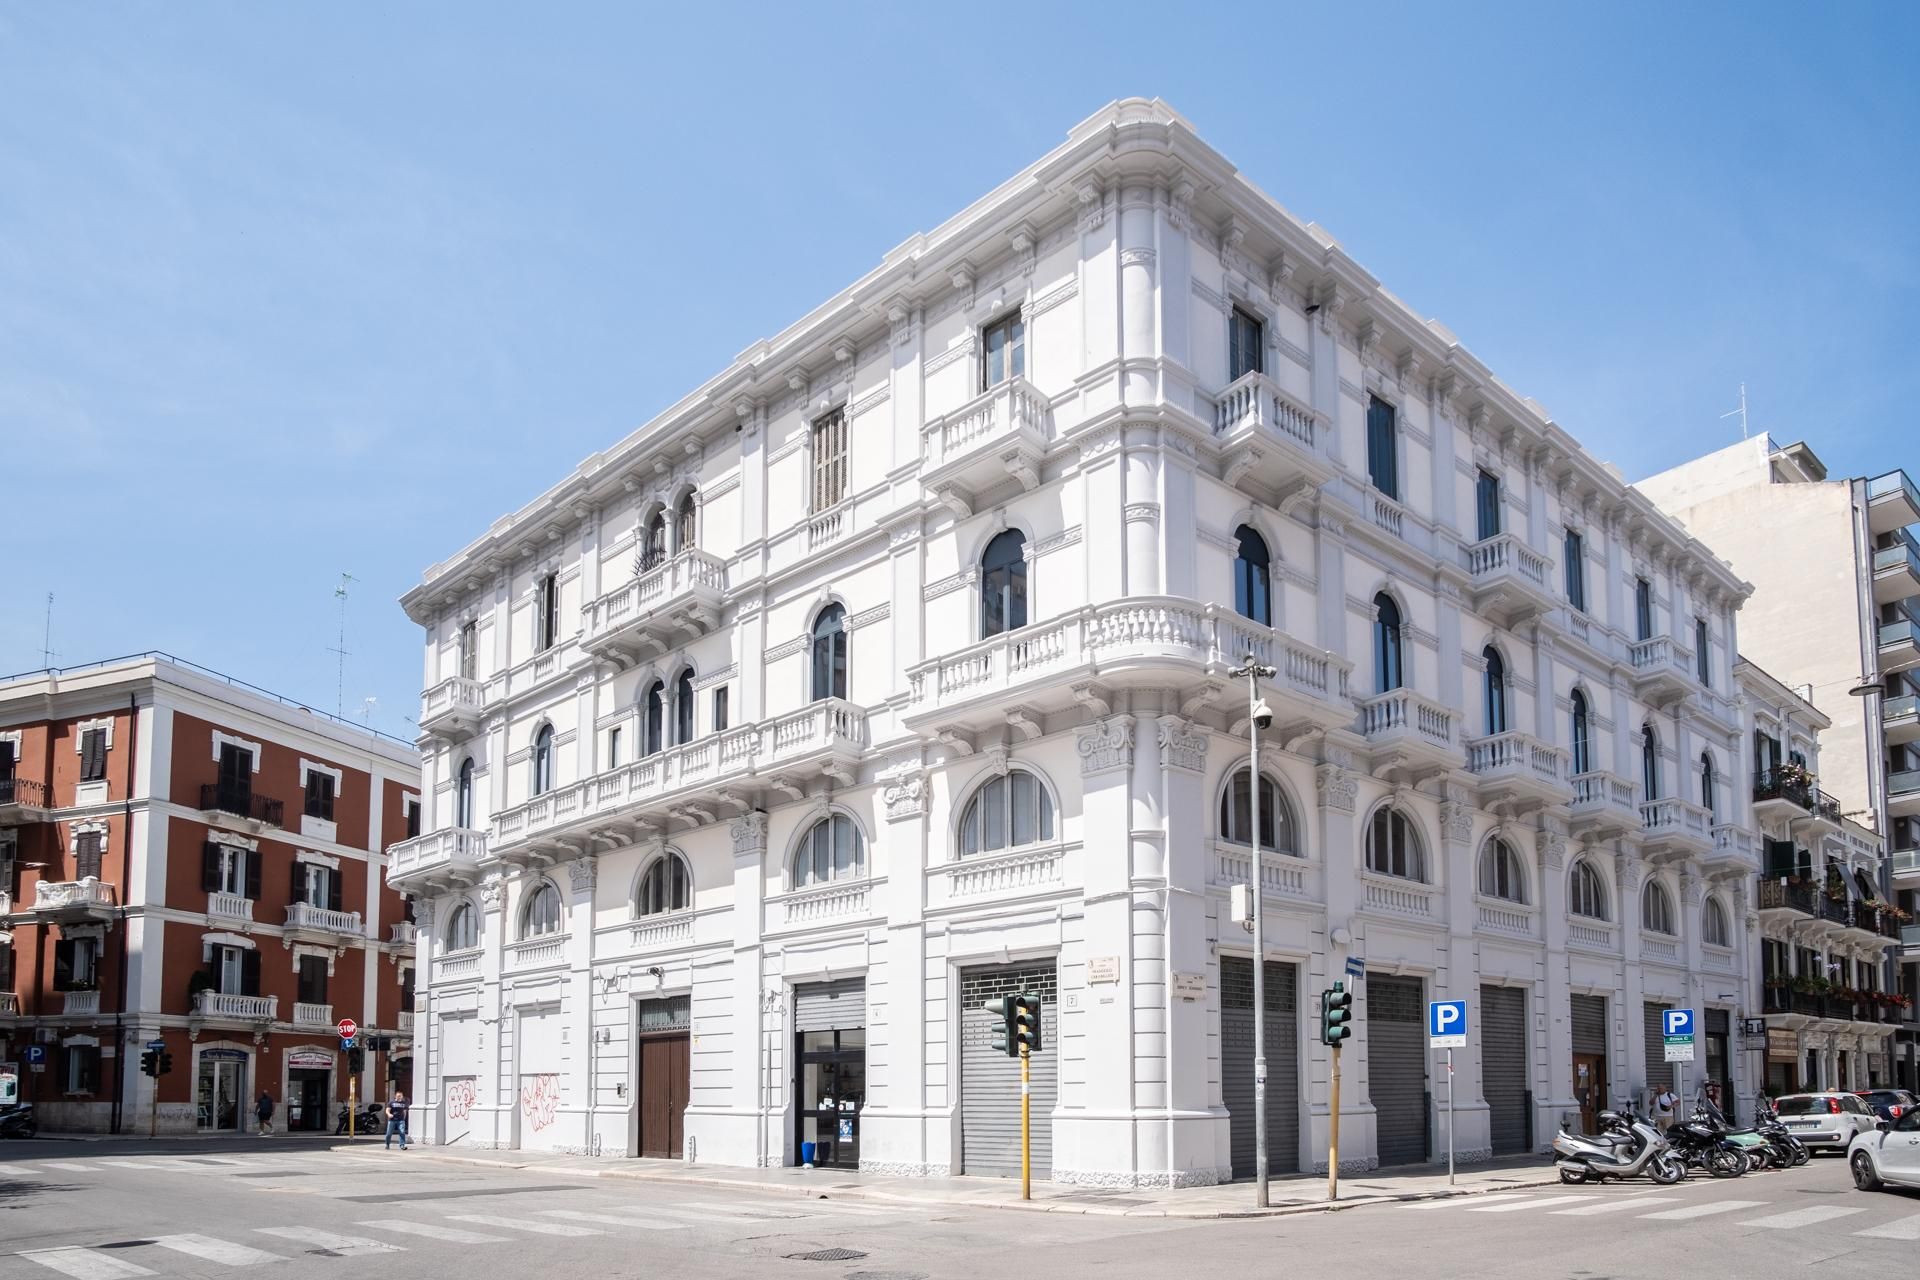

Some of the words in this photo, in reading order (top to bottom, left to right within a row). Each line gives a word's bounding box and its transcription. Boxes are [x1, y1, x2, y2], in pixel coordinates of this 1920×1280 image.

[1437, 1004, 1459, 1033] P
[1669, 1012, 1688, 1033] P
[339, 1025, 355, 1033] STOP
[31, 1047, 42, 1061] P
